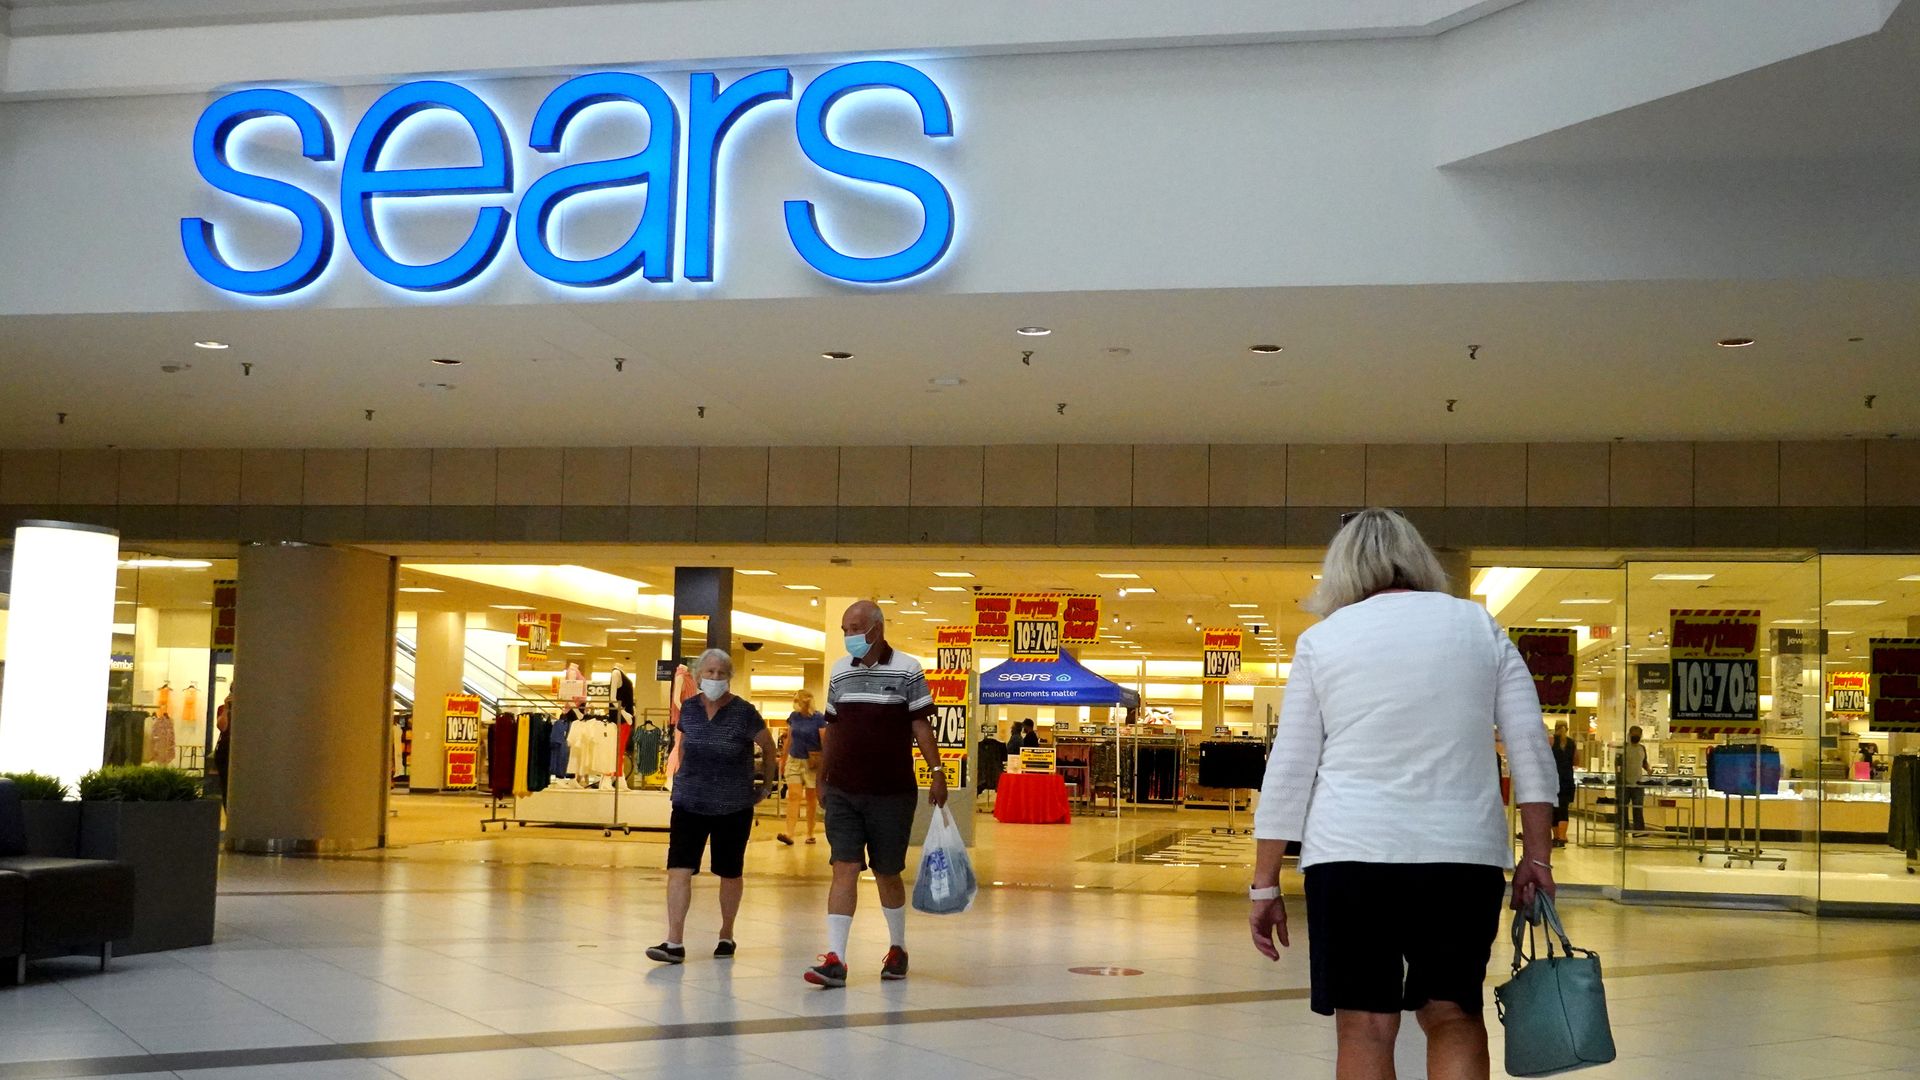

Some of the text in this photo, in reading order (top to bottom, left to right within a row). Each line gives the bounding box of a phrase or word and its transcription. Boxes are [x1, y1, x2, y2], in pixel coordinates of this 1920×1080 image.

[181, 60, 955, 295] sears
[1592, 625, 1610, 638] EXIT
[1671, 618, 1758, 654] Everything
[998, 673, 1052, 682] sears
[982, 690, 1011, 699] making
[1012, 690, 1050, 698] moments
